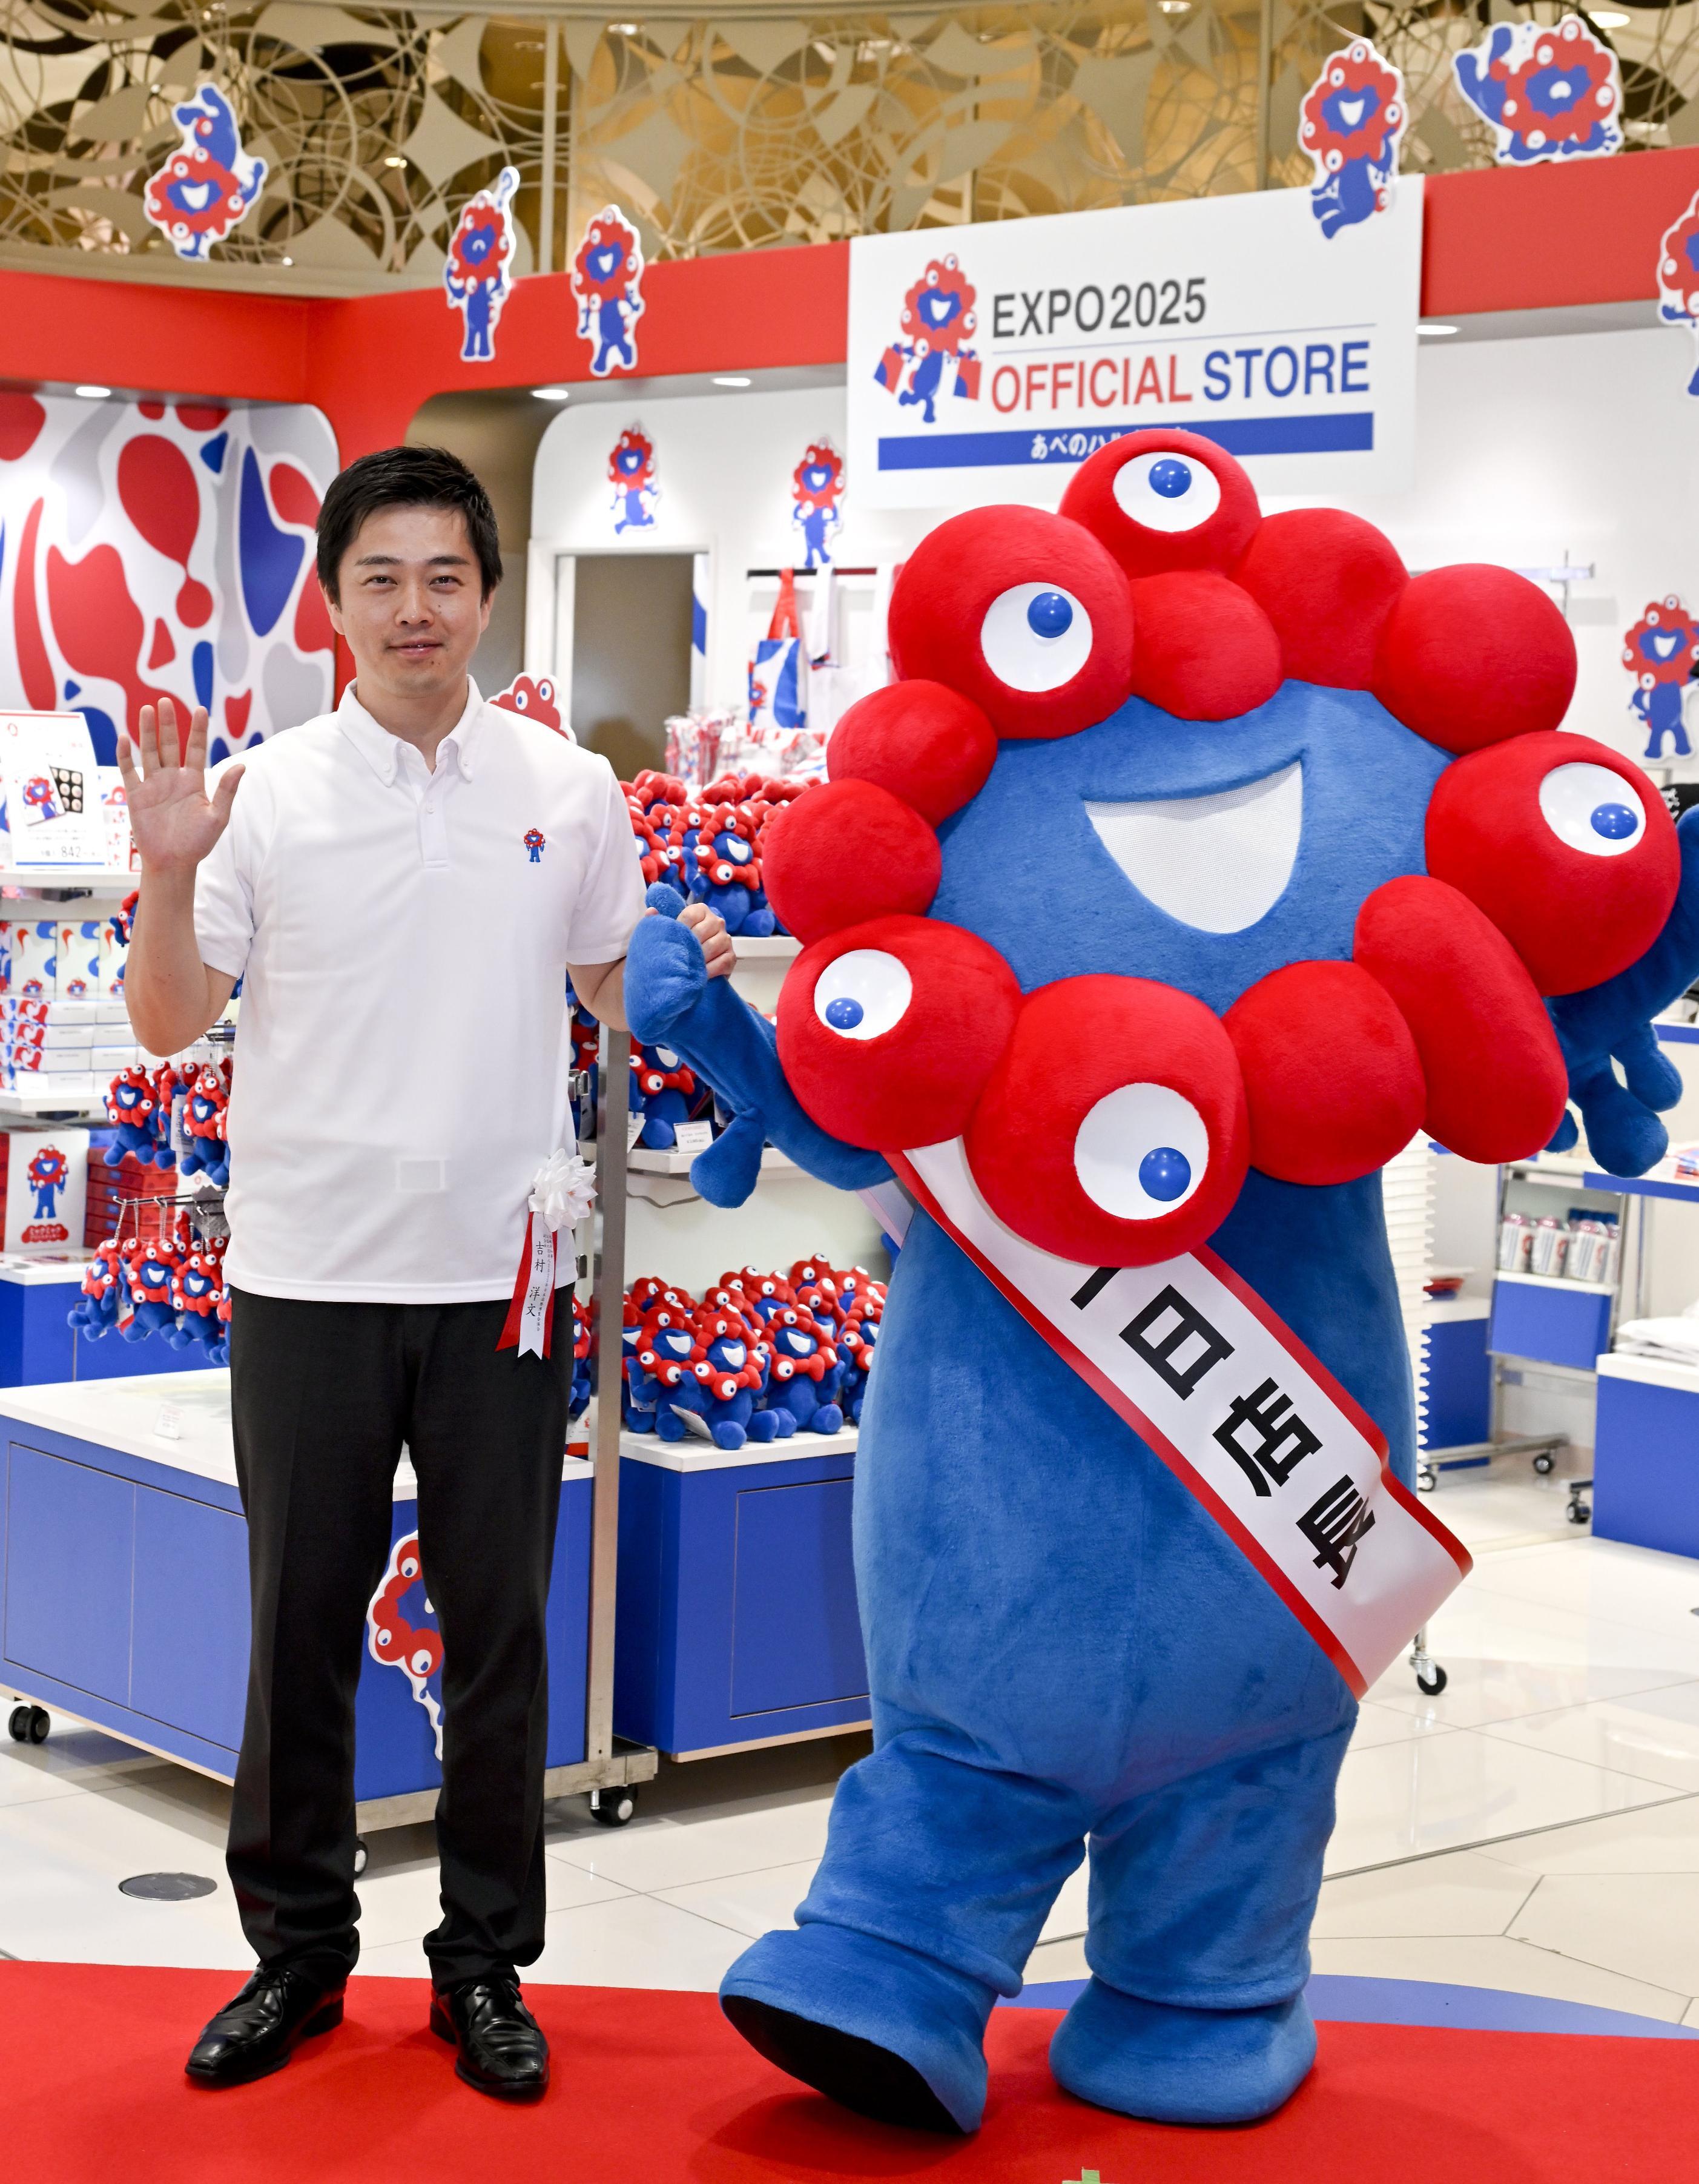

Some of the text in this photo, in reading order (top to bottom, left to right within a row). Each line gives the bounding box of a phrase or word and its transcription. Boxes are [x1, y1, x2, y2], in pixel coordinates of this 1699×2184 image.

[992, 341, 1369, 413] OFFICIAL STORE
[1031, 427, 1141, 460] あべのハ
